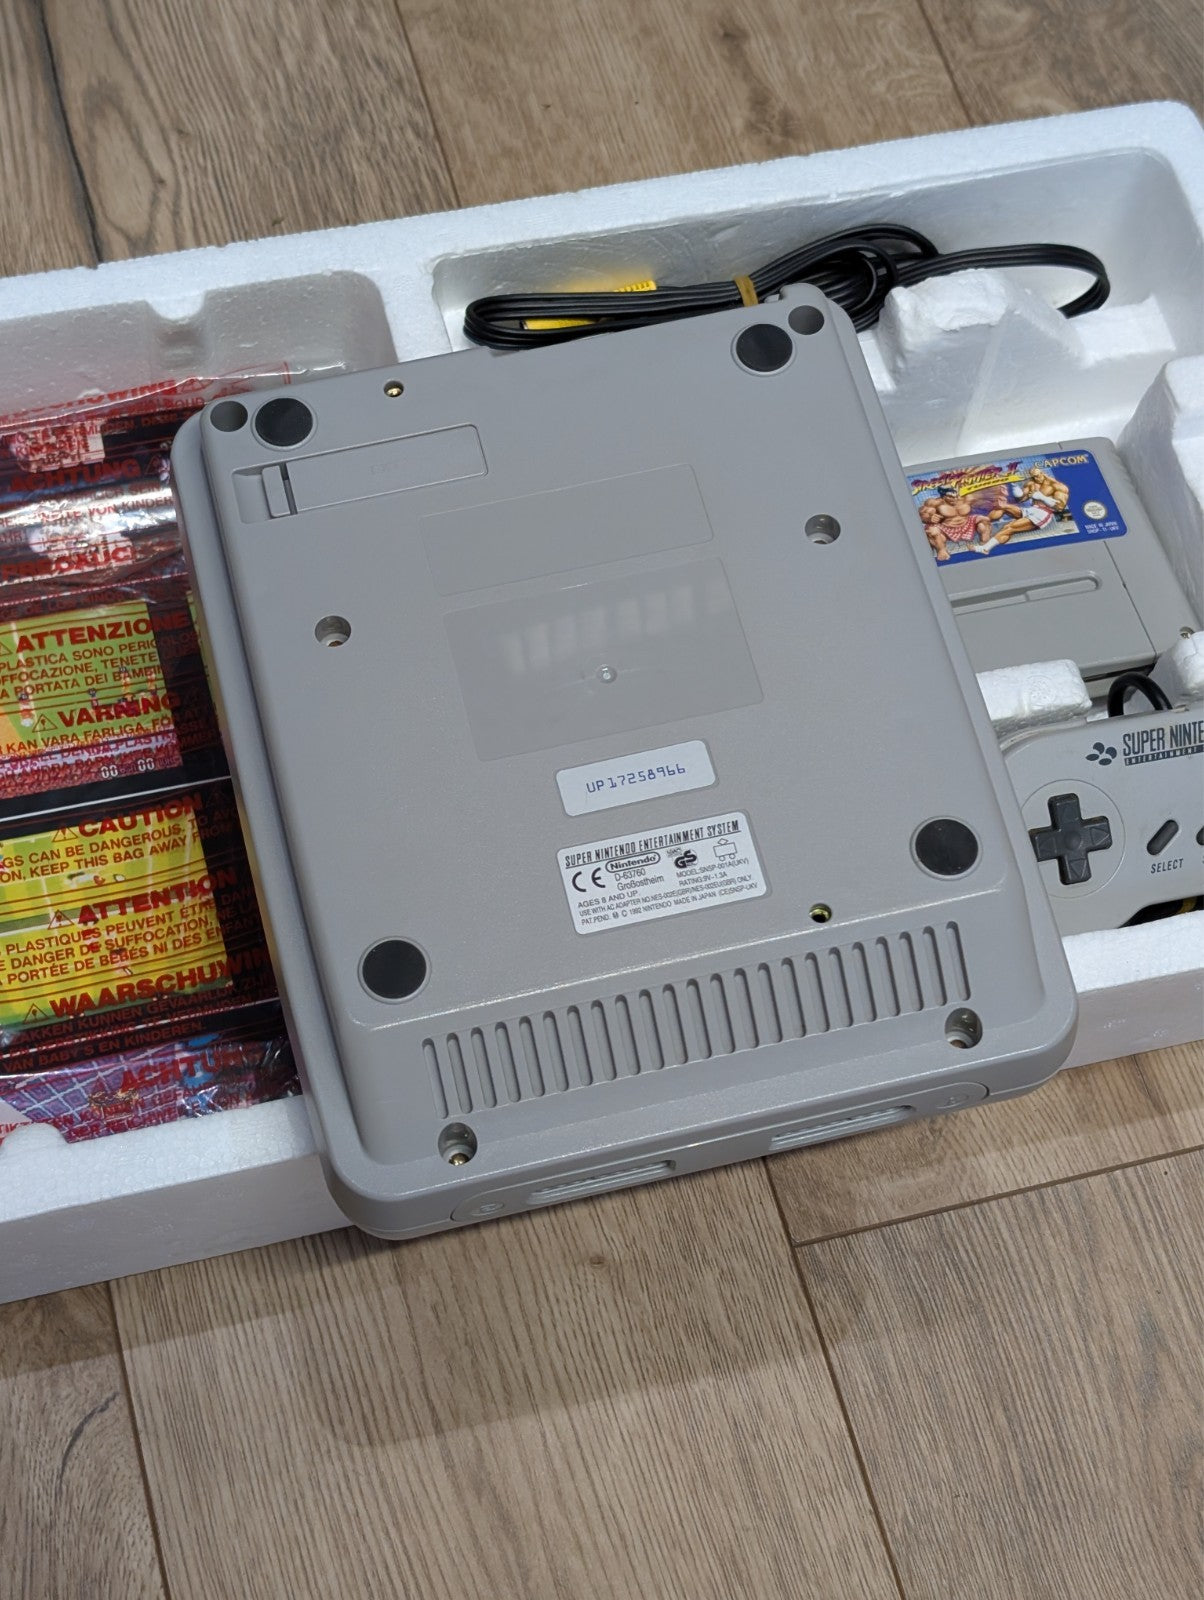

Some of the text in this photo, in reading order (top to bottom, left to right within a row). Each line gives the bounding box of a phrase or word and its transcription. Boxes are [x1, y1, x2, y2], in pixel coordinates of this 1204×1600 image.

[10, 455, 142, 491] ACHTUNG
[1034, 454, 1088, 469] CAPCOM
[16, 612, 186, 652] ATTENZIONE
[73, 646, 115, 662] SONO
[0, 662, 98, 686] FFOCAZIONE,
[15, 679, 80, 697] PORTATA
[84, 674, 108, 686] DEI
[58, 692, 181, 728] VARNING
[6, 739, 38, 754] KAN
[41, 733, 80, 749] VARA
[1123, 727, 1165, 757] SUPER
[1125, 746, 1197, 766] ENTERTAINMENT
[586, 763, 687, 793] UP17258966
[78, 791, 203, 838] CAUTION
[28, 850, 61, 864] CAN
[65, 846, 85, 859] BE
[565, 819, 739, 867] SUPER NINTENDO ENTERTAINMENT SYSTEM
[30, 861, 70, 878] KEEP
[73, 855, 109, 871] THIS
[113, 848, 145, 864] BAG
[149, 835, 187, 856] AWAY
[609, 854, 657, 870] Nintendo
[1150, 857, 1184, 874] SELECT
[614, 868, 646, 882] D-63760
[617, 874, 664, 892] Großostheim
[78, 867, 237, 926] ATTENTION
[578, 889, 638, 909] AGES 8 AND UP
[579, 908, 593, 917] USE
[592, 905, 607, 915] WITH
[607, 903, 616, 911] AC
[615, 898, 641, 910] ADAPTER
[642, 900, 672, 913] NINTENDO
[673, 896, 691, 906] MADE
[691, 894, 698, 902] IN
[698, 890, 717, 901] JAPAN
[6, 928, 101, 955] PLASTIQUES
[105, 911, 174, 936] PEUVENT
[11, 948, 75, 970] DANGER
[81, 940, 102, 955] DE
[105, 917, 214, 951] SUFFOCATION,
[7, 962, 67, 984] PORTÉE
[74, 958, 95, 974] DE
[100, 946, 149, 967] BÉBÉS
[153, 942, 169, 956] NI
[172, 933, 202, 951] DES
[77, 1007, 143, 1031] KUNNEN
[3, 1058, 33, 1073] VAN
[100, 1037, 120, 1051] EN
